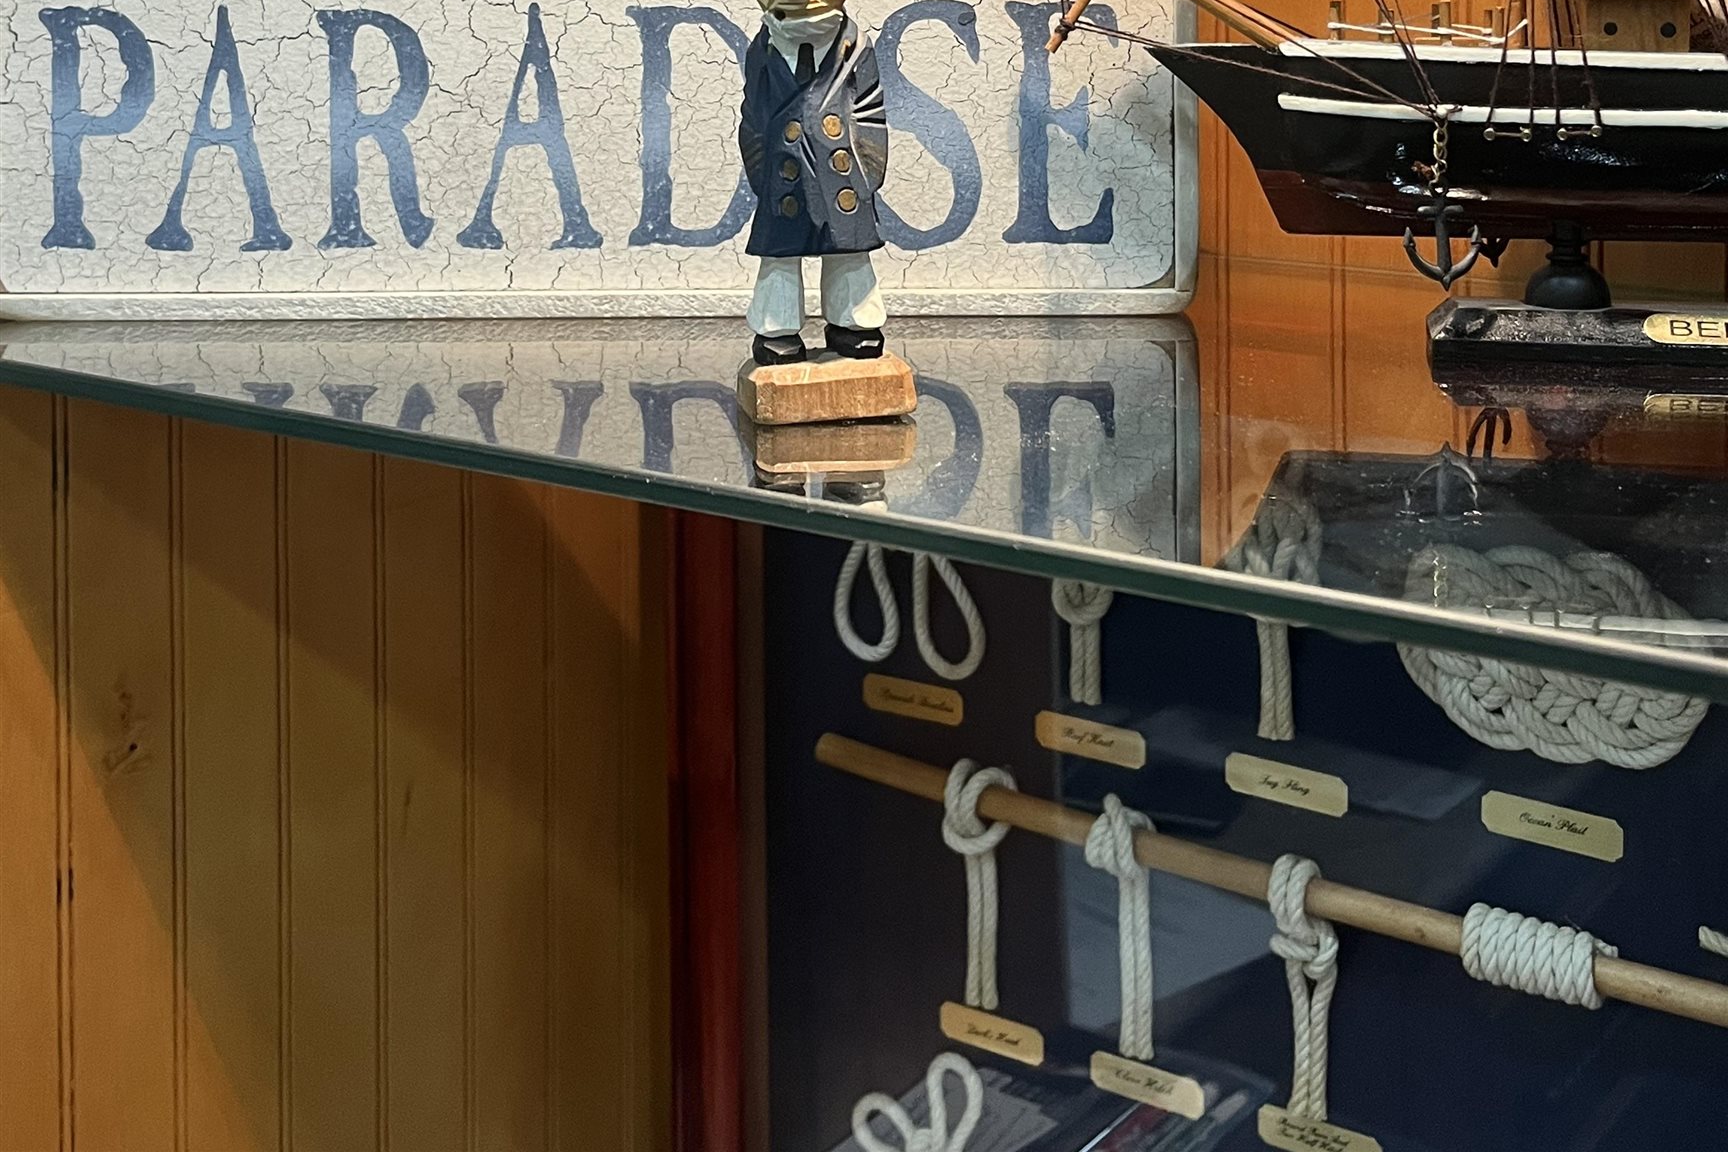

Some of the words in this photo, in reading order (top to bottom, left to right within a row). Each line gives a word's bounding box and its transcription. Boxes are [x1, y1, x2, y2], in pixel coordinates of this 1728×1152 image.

[38, 3, 1118, 250] PARADSE
[1669, 320, 1728, 338] BE
[1519, 811, 1552, 828] Ocean
